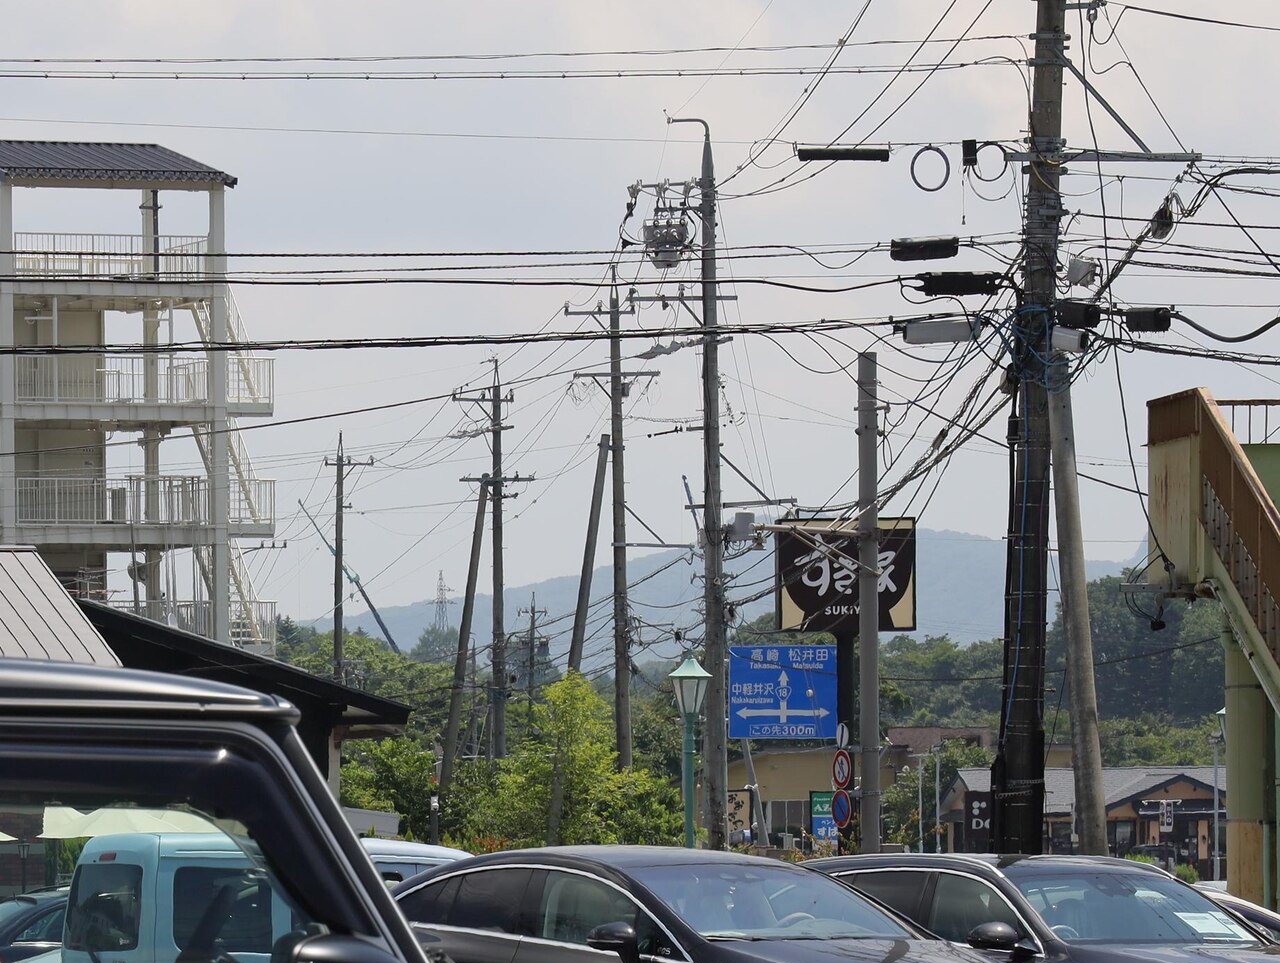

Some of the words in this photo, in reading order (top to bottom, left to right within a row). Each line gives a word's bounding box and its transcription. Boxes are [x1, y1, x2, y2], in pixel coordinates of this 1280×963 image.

[751, 649, 780, 662] 高崎
[788, 649, 828, 662] 松井田
[732, 683, 775, 696] 中軽井沢
[778, 689, 788, 697] 18
[752, 726, 815, 735] この先300m
